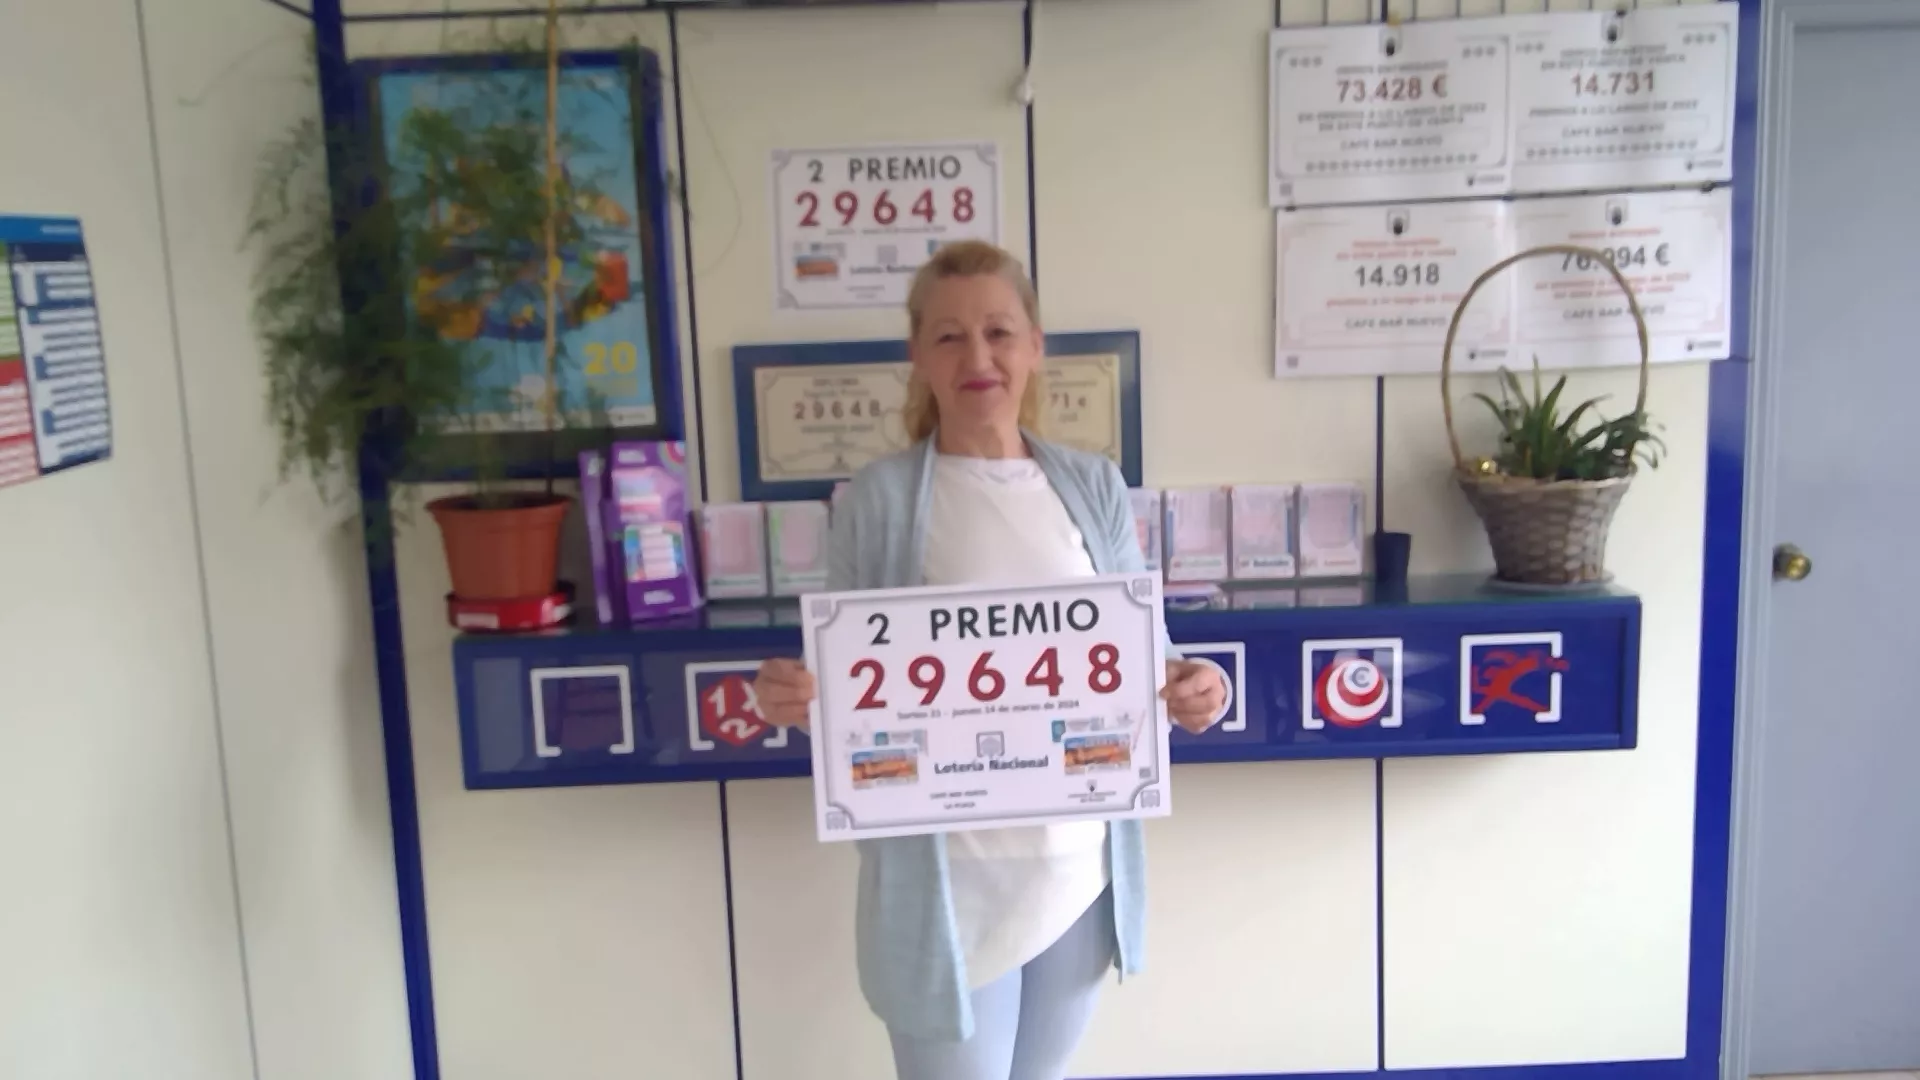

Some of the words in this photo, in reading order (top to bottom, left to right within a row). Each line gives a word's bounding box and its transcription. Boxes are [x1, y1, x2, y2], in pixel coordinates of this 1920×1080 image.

[1336, 76, 1423, 103] 73.428
[1432, 73, 1449, 99] €
[1571, 70, 1655, 97] 14.731
[807, 159, 824, 183] 2
[848, 155, 962, 182] PREMIO
[1655, 243, 1670, 266] €
[1354, 262, 1440, 288] 14.918
[867, 612, 891, 645] 2
[929, 599, 1100, 641] PREMIO
[850, 642, 1122, 711] 29648
[934, 759, 985, 775] Lotería
[989, 754, 1049, 772] Nacional
